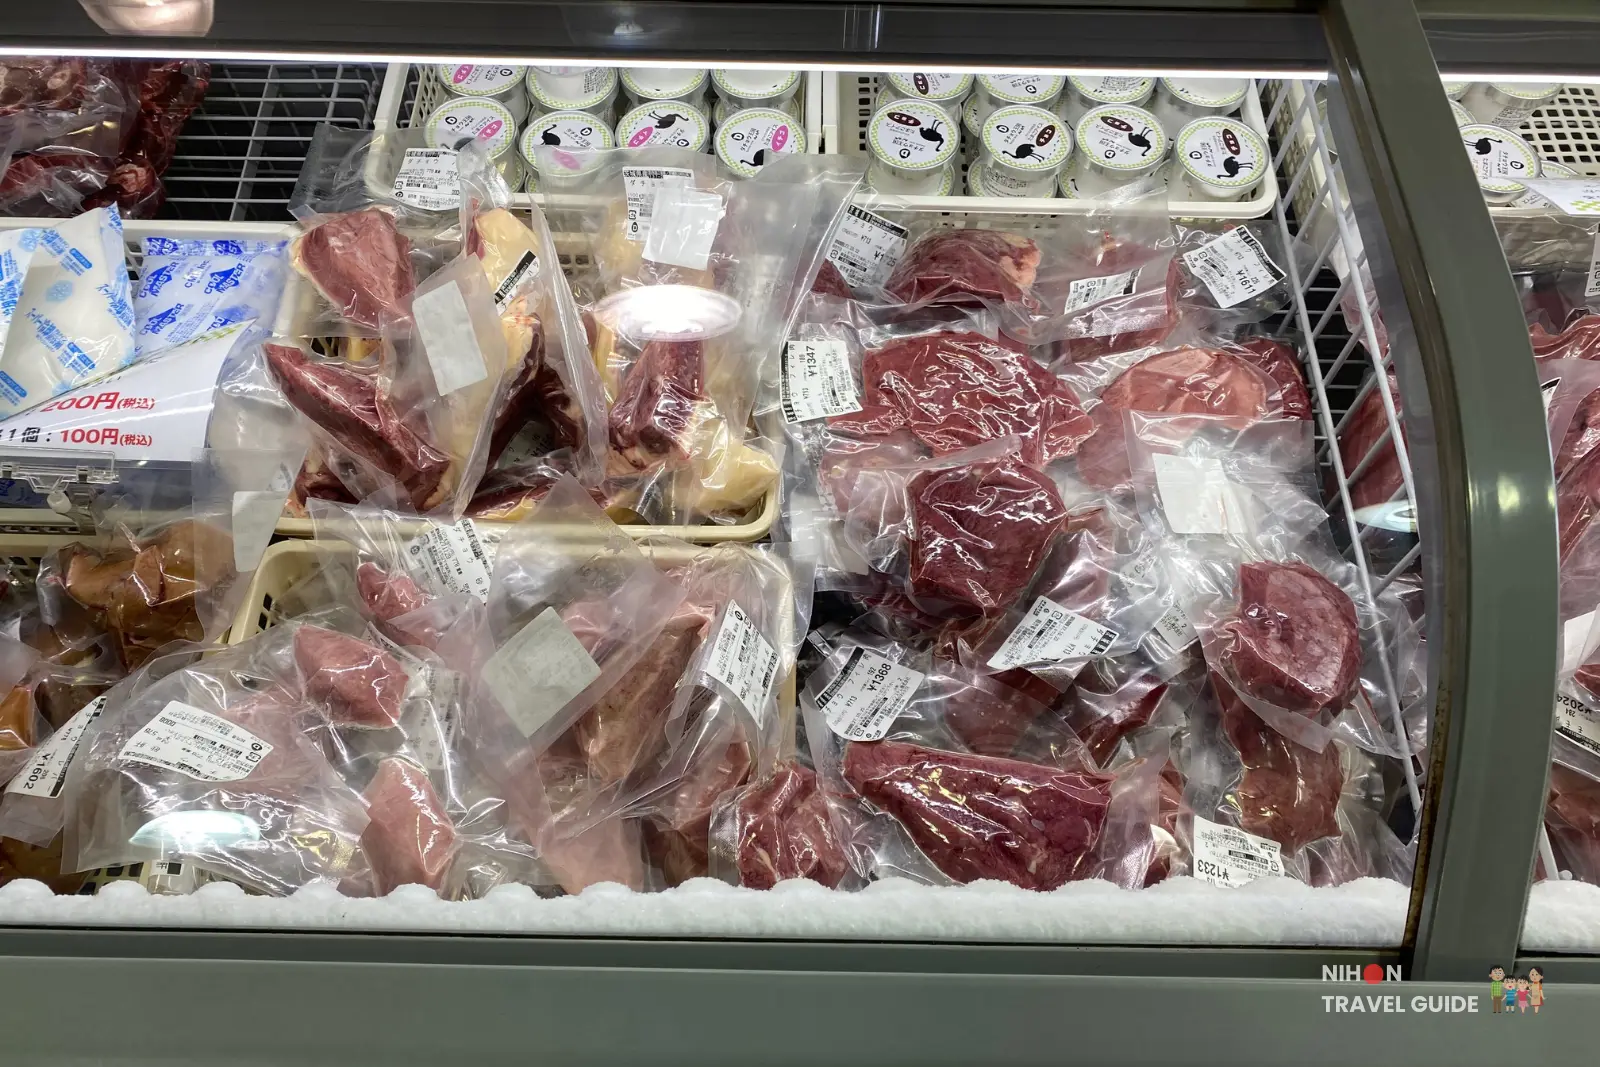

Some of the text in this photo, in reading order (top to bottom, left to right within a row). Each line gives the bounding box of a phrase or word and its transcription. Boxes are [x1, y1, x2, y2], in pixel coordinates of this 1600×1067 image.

[775, 130, 786, 147] イチゴ
[139, 273, 158, 299] COOL
[150, 261, 180, 297] MASTER
[204, 274, 225, 295] COOL
[216, 262, 246, 293] MASTER
[1236, 270, 1257, 294] ¥1611
[150, 303, 185, 335] MASTER
[806, 345, 818, 378] ¥1347
[867, 663, 892, 692] ¥1368
[23, 753, 52, 790] ¥1602
[1198, 859, 1230, 881] ¥1233
